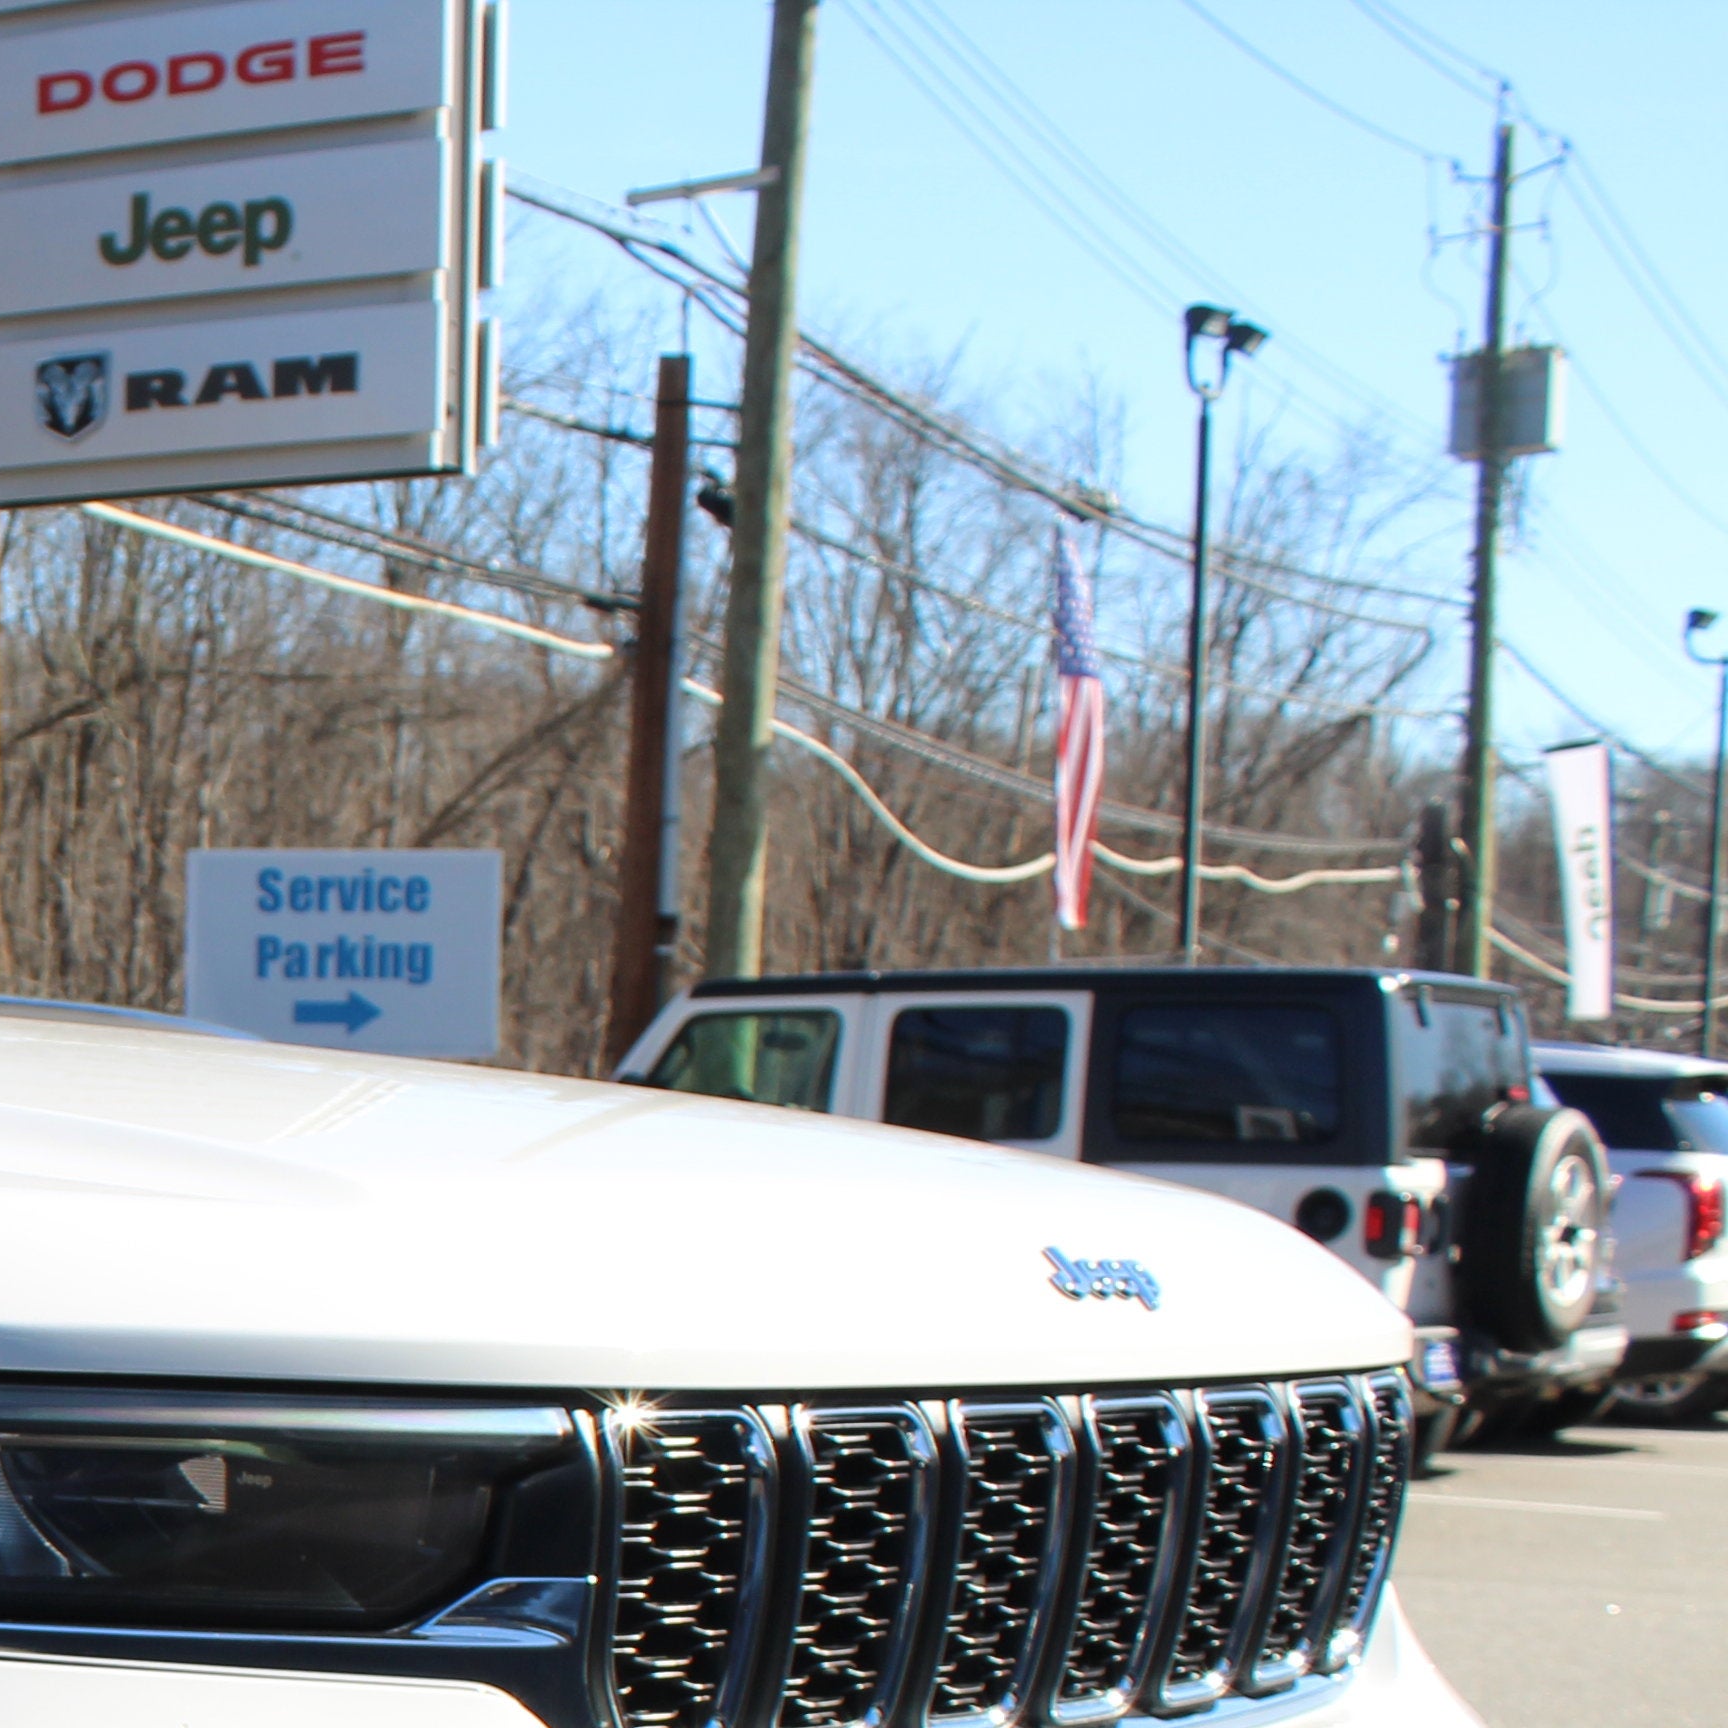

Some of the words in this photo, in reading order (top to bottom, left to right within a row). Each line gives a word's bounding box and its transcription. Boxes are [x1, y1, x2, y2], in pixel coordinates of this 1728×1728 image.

[37, 31, 367, 115] DODGE
[98, 192, 294, 267] Jeep
[124, 352, 359, 412] RAM
[257, 866, 431, 913] Service
[256, 934, 433, 984] Parking
[1042, 1246, 1160, 1310] Jeep
